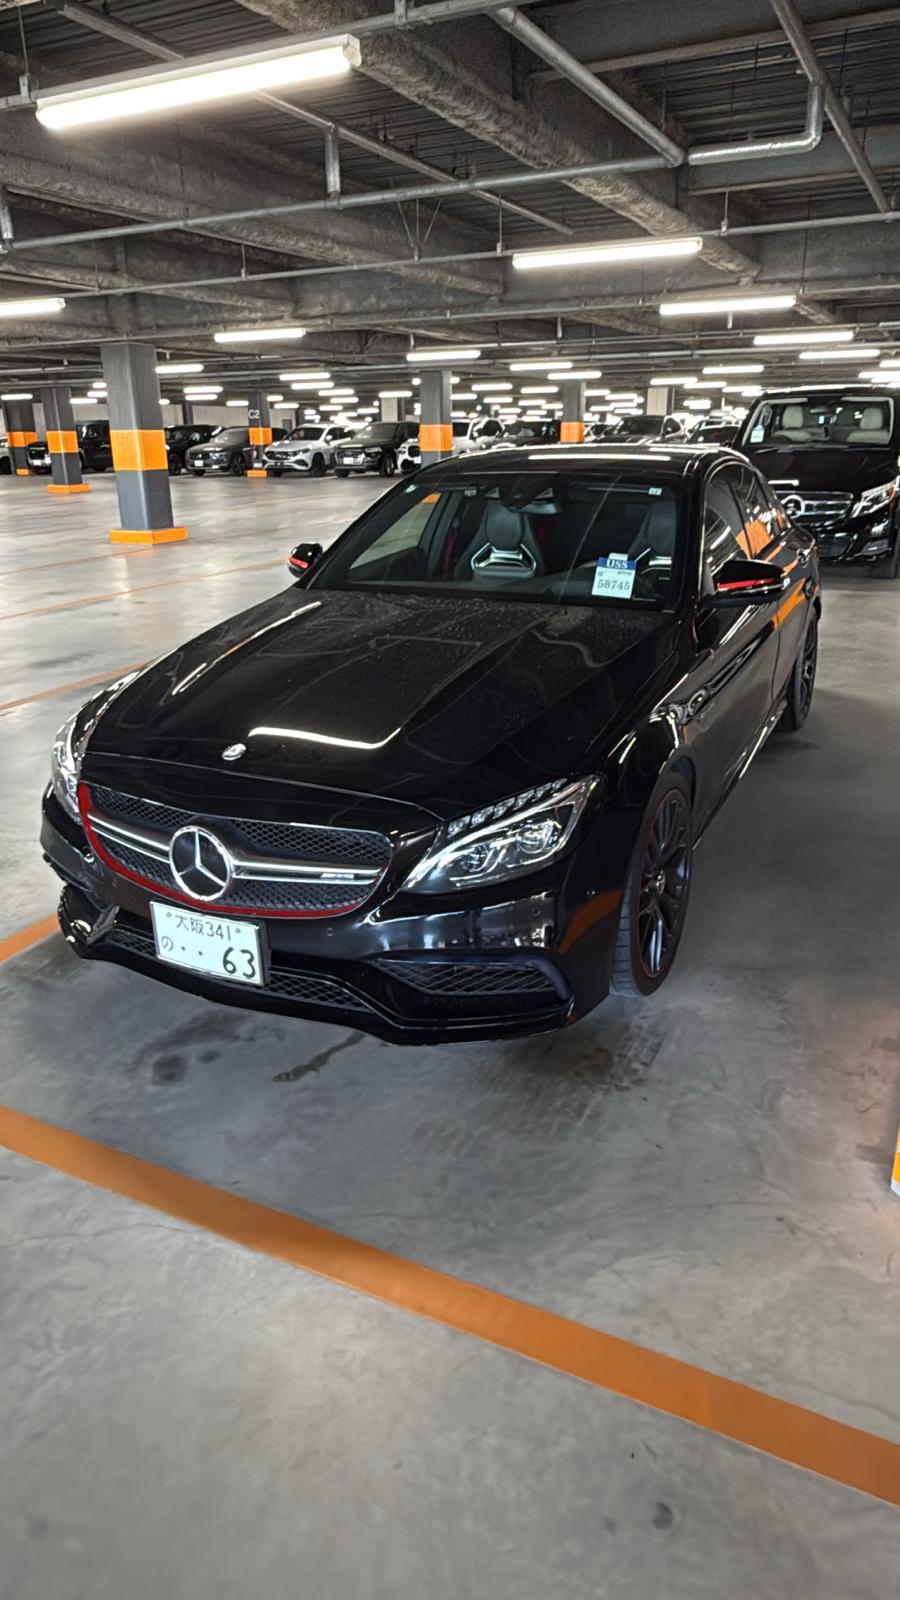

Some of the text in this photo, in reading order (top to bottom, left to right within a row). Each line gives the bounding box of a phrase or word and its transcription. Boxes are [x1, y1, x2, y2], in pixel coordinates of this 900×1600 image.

[248, 409, 260, 419] C2
[606, 559, 628, 569] USS
[597, 579, 630, 591] 58745
[160, 935, 174, 952] の
